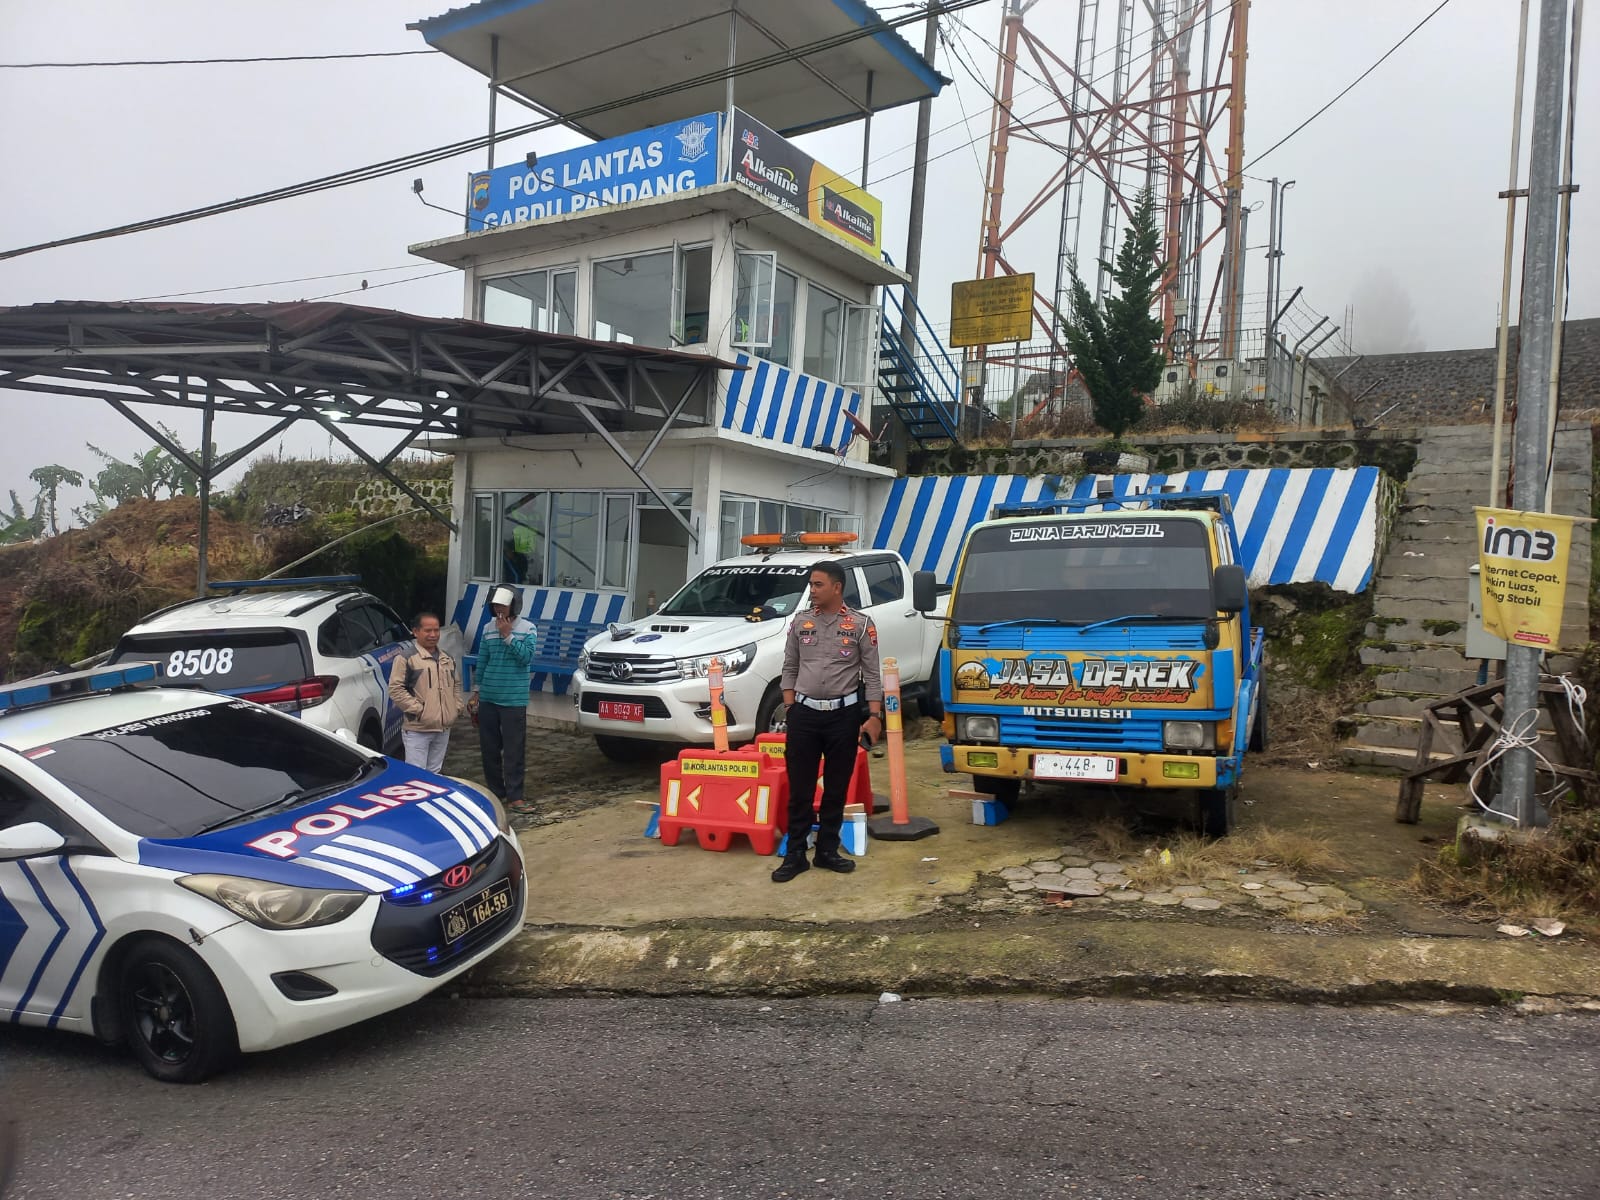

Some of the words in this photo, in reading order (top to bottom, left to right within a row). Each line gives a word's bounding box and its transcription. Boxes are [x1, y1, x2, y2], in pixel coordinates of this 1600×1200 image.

[509, 167, 555, 200] POS
[562, 141, 664, 188] LANTAS
[740, 148, 799, 196] Alkaline
[483, 199, 562, 231] GARDU
[571, 169, 696, 212] PANDANG
[764, 188, 780, 203] Luar
[834, 203, 872, 234] Alkaline
[1009, 525, 1060, 542] DUNIA
[1061, 524, 1108, 540] BARU
[1109, 523, 1165, 539] MOBIL
[704, 567, 764, 577] PATROLI
[767, 567, 809, 577] LLAJ
[1520, 570, 1560, 585] Cepat,
[1508, 580, 1538, 594] Luas,
[1507, 593, 1541, 607] Stabil
[166, 647, 234, 677] 8508
[989, 658, 1073, 688] JASA
[1080, 659, 1196, 690] DEREK
[995, 683, 1018, 700] 24
[1022, 683, 1058, 700] hours
[1058, 684, 1083, 706] for
[1084, 686, 1126, 706] traffic
[1129, 690, 1190, 704] accident
[600, 703, 609, 714] AA
[633, 706, 643, 717] XF
[1023, 706, 1133, 719] MITSUBISHI
[94, 722, 147, 739] POLRES
[690, 761, 728, 773] KORLANTAS
[729, 764, 749, 773] POLRI
[246, 779, 449, 858] POLISI
